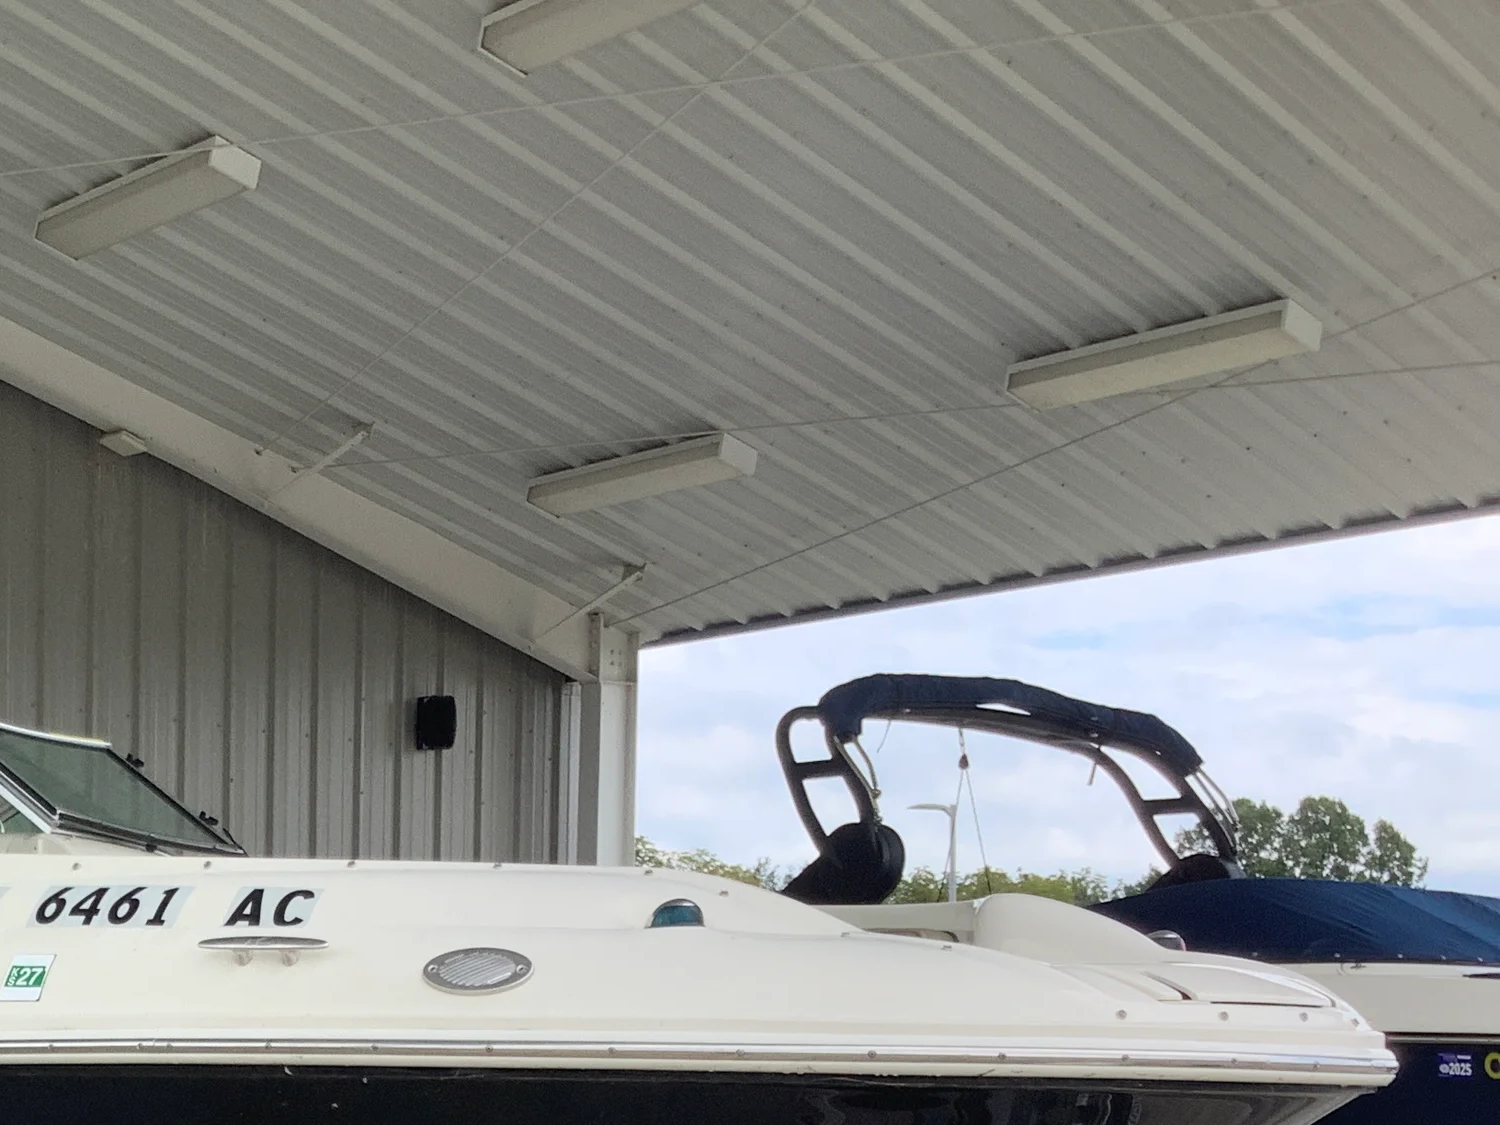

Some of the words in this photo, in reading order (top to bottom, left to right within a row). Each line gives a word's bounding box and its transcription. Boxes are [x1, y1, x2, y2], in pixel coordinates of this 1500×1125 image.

[35, 886, 180, 926] 6461
[224, 888, 315, 926] AC
[15, 967, 44, 986] 27
[1449, 1062, 1472, 1076] 2025
